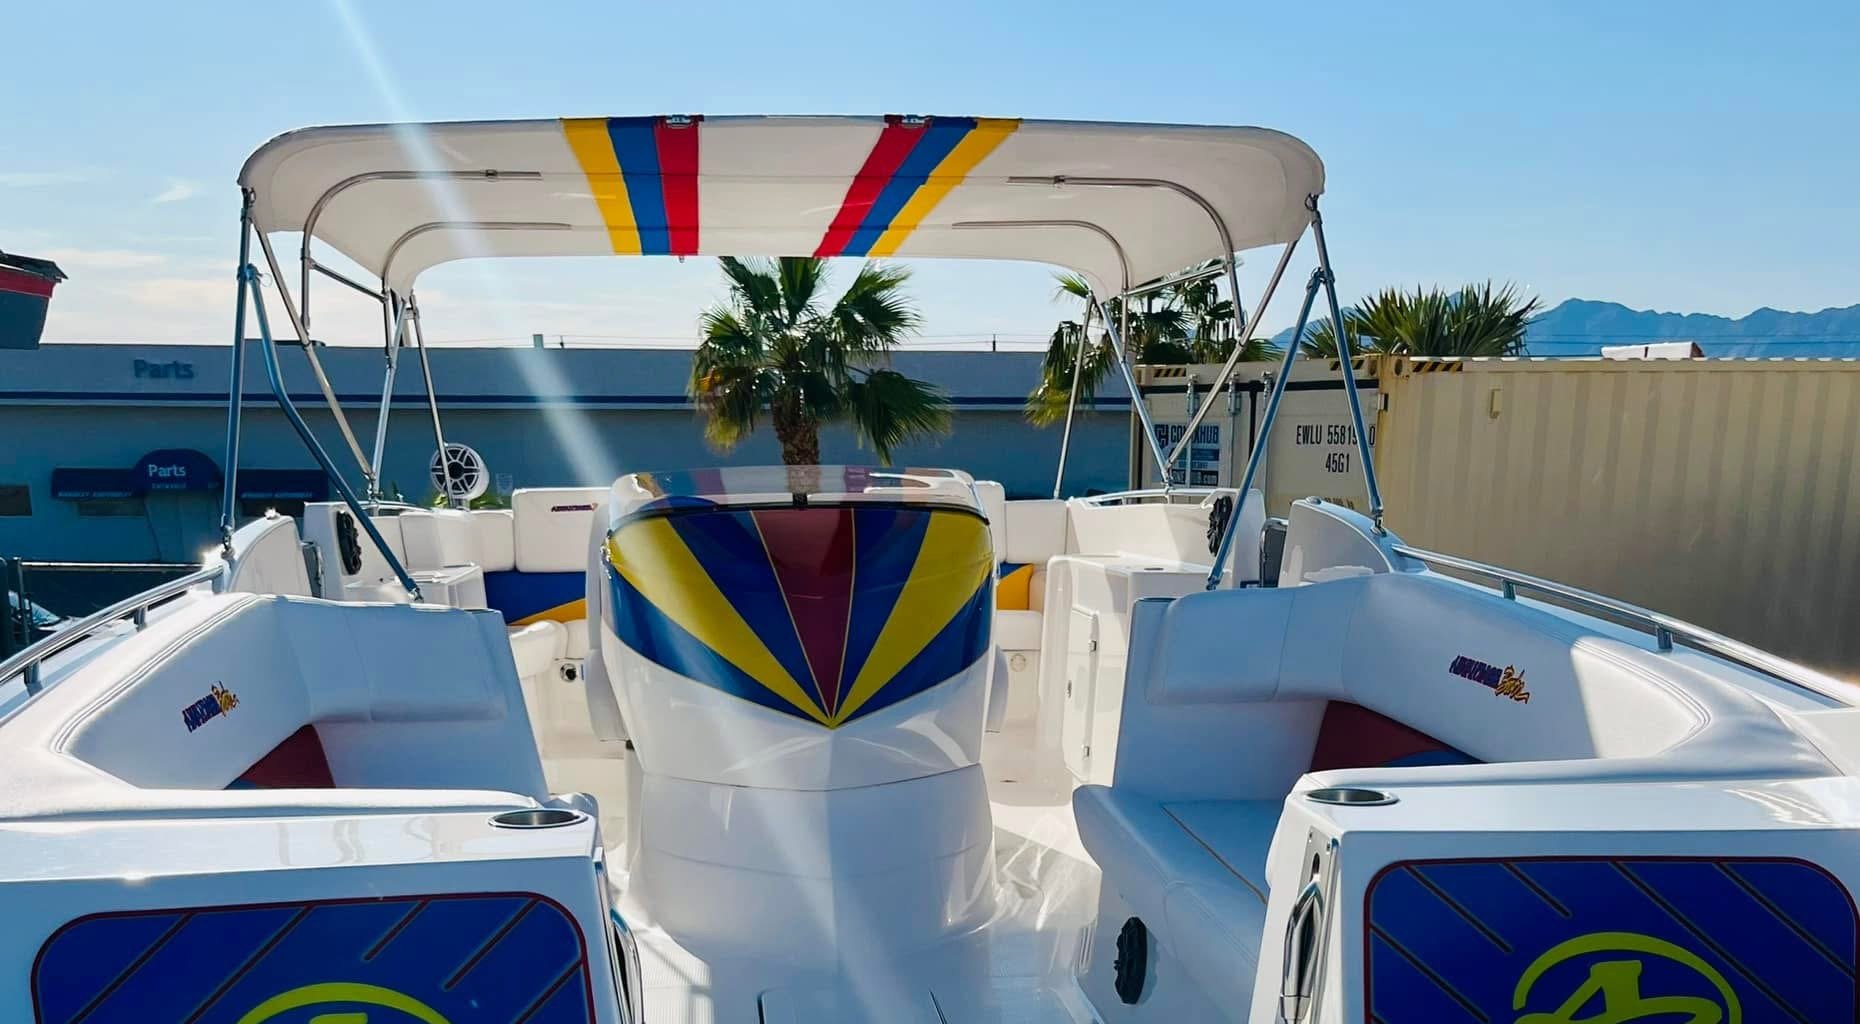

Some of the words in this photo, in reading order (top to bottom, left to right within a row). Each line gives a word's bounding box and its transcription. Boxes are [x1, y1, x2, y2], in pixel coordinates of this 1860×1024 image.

[133, 359, 194, 379] Parts
[1296, 424, 1322, 445] EWLU
[148, 463, 187, 477] Parts
[1325, 453, 1350, 473] 45G1
